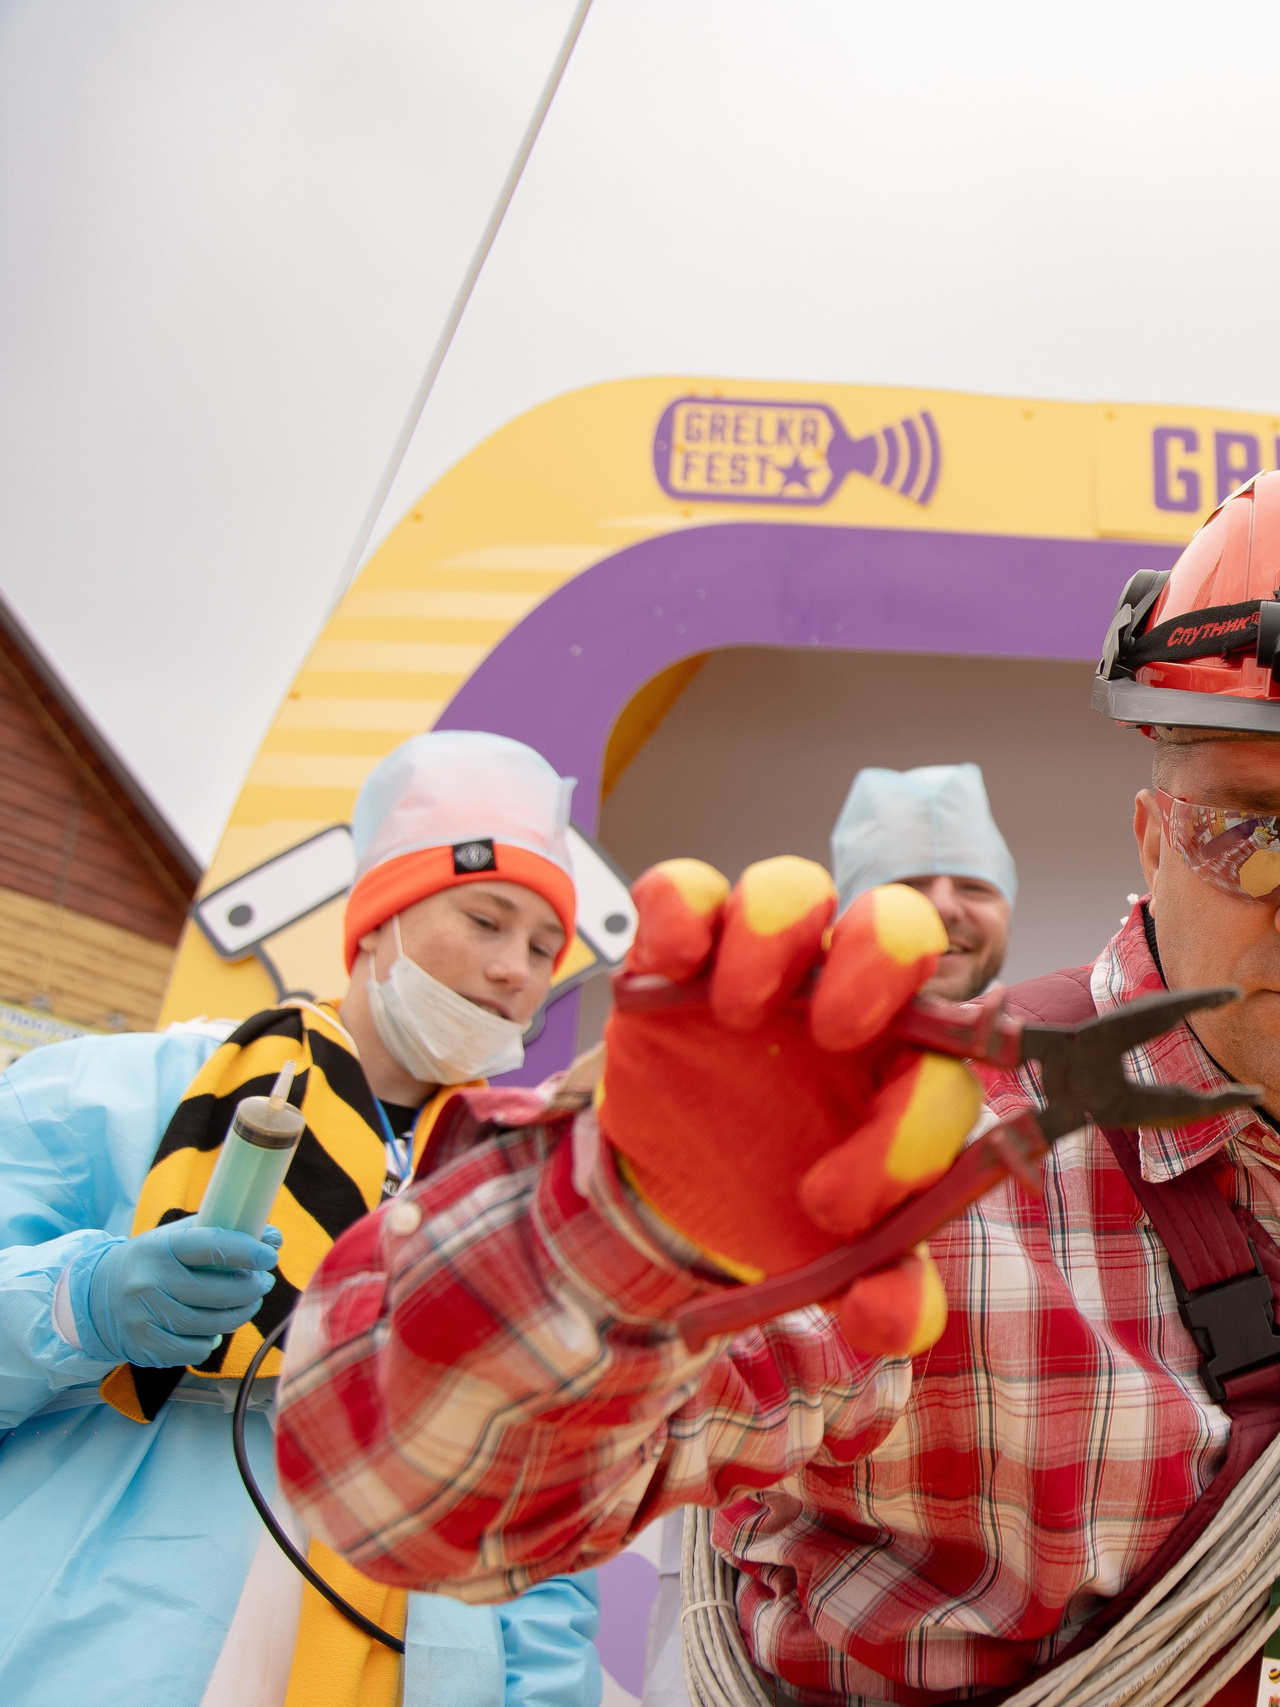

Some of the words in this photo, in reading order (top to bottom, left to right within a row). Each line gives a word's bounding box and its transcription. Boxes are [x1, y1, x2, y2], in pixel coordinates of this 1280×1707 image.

[684, 411, 819, 447] GRELKA
[681, 452, 771, 486] FEST
[1166, 615, 1252, 648] СПУТНИК
